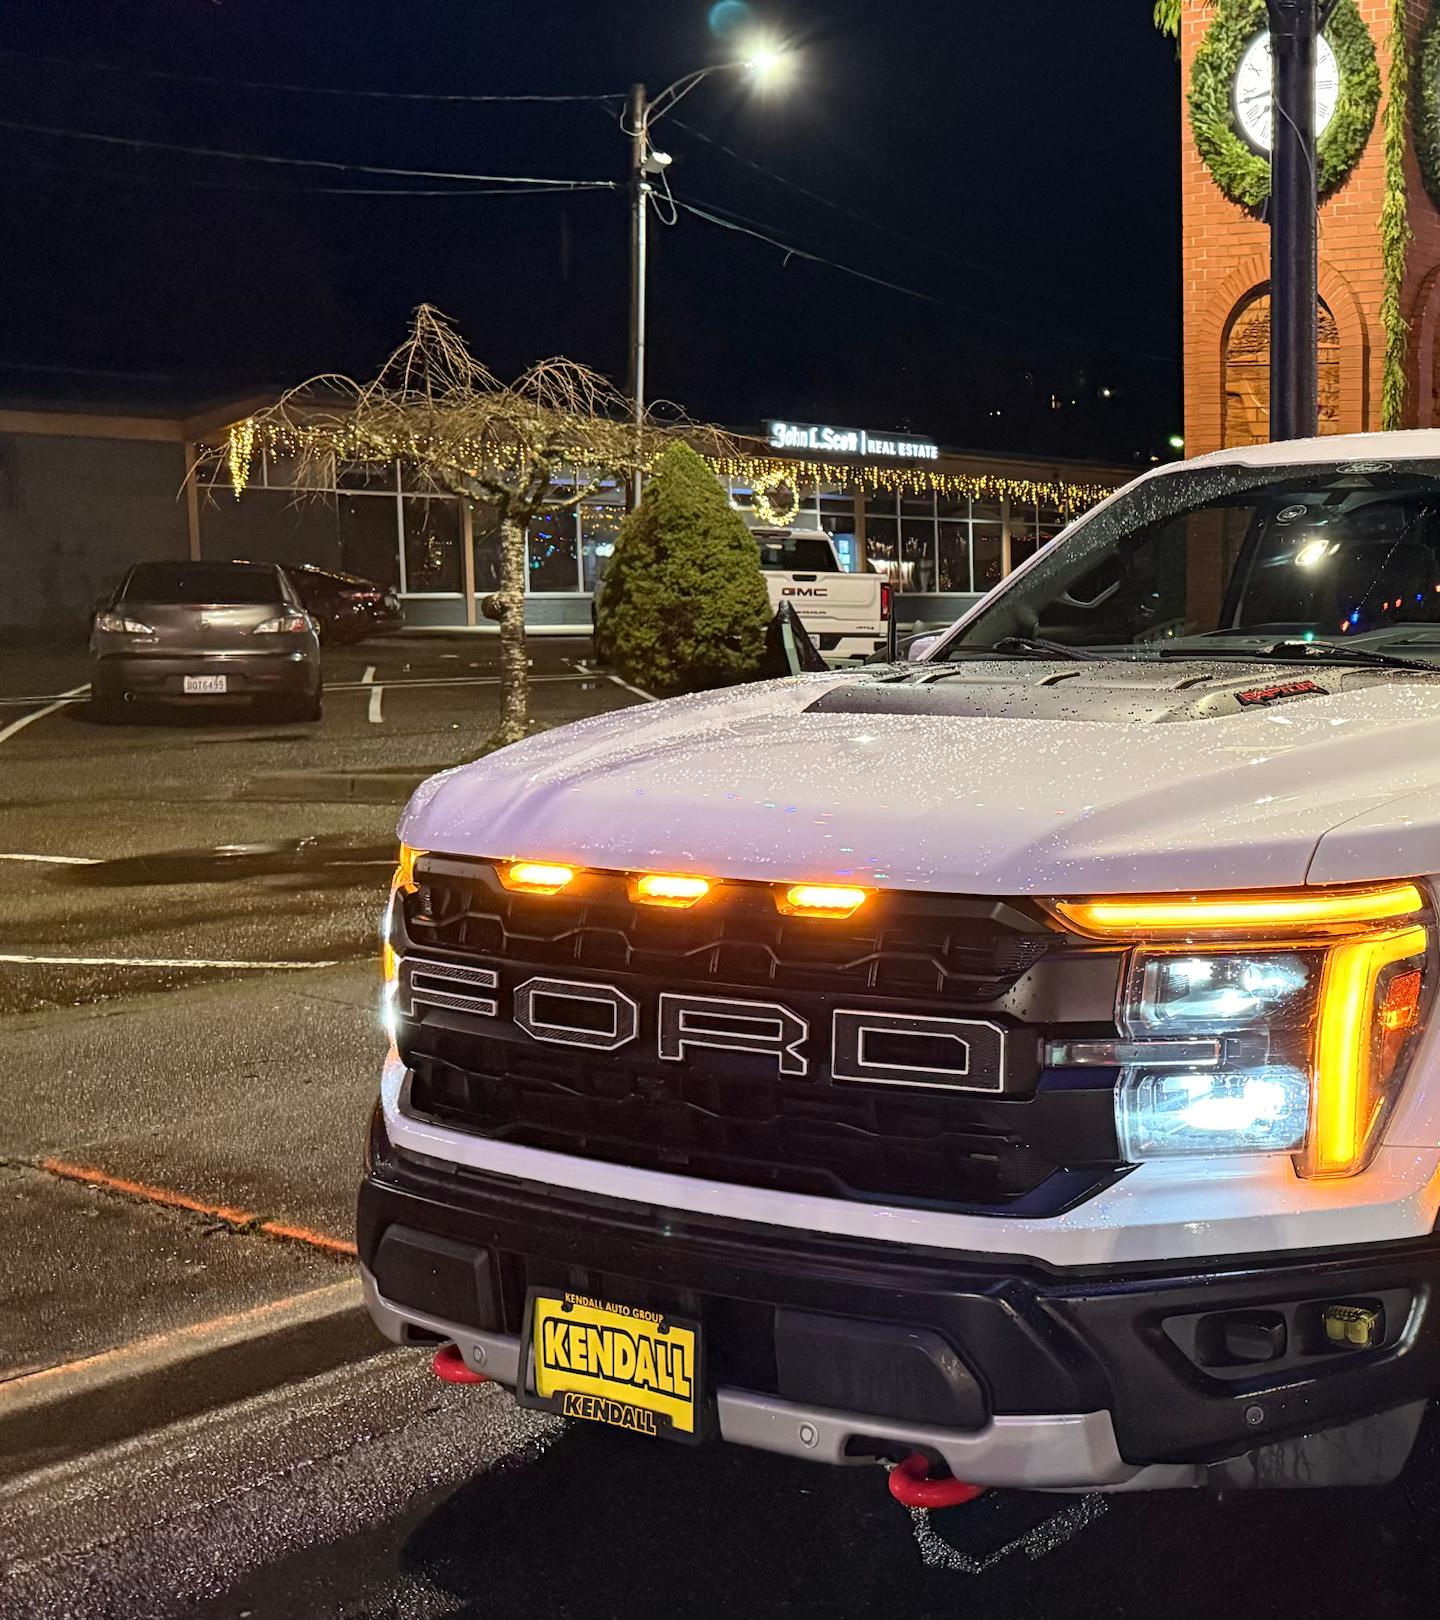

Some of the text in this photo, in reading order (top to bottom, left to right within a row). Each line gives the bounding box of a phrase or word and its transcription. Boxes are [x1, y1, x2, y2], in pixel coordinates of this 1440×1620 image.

[770, 422, 808, 448] John
[822, 428, 857, 452] Scott
[868, 440, 896, 455] REAL
[898, 442, 938, 459] ESTATE
[782, 587, 828, 597] GMC
[1240, 681, 1314, 701] RAPTOR
[397, 955, 1005, 1094] FORD
[565, 1292, 664, 1323] KENDALL AUTO GROUP
[544, 1318, 693, 1401] KENDALL
[563, 1393, 657, 1436] KENDALL
